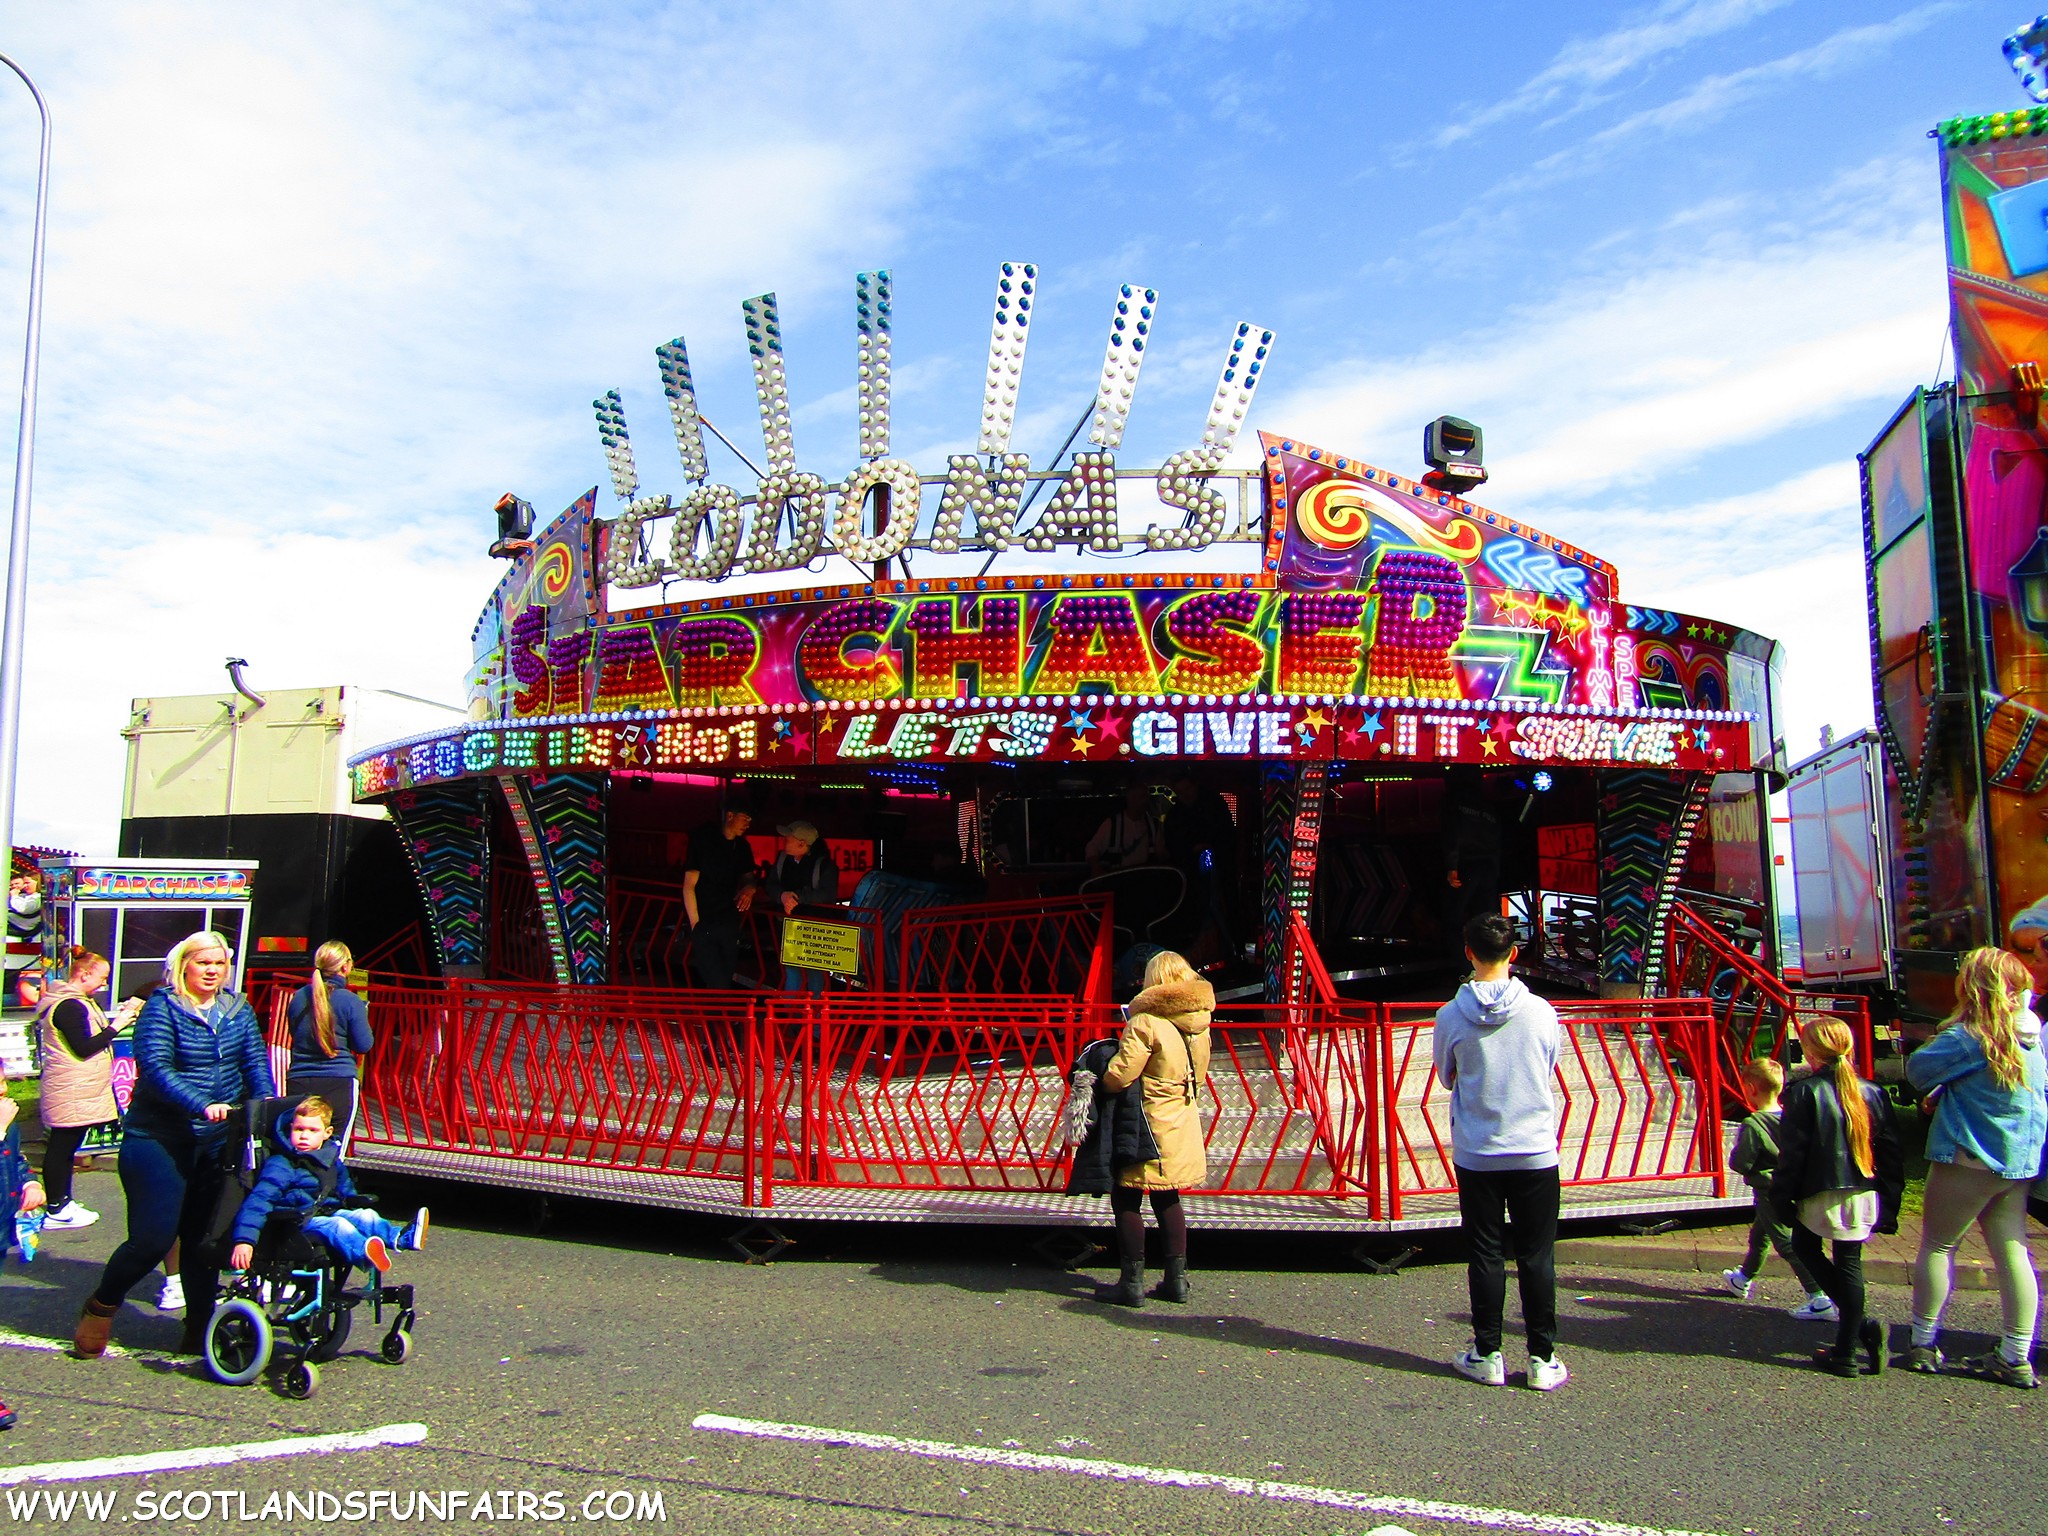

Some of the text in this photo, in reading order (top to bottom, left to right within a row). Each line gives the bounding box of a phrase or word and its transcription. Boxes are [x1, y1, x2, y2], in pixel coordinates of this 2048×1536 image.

[606, 448, 1228, 589] CODONAS
[802, 548, 1469, 705] CHASER
[837, 710, 1686, 766] LETS GIVE IT SOME
[82, 870, 247, 899] STARCHASER
[809, 942, 836, 950] COMPLETELY
